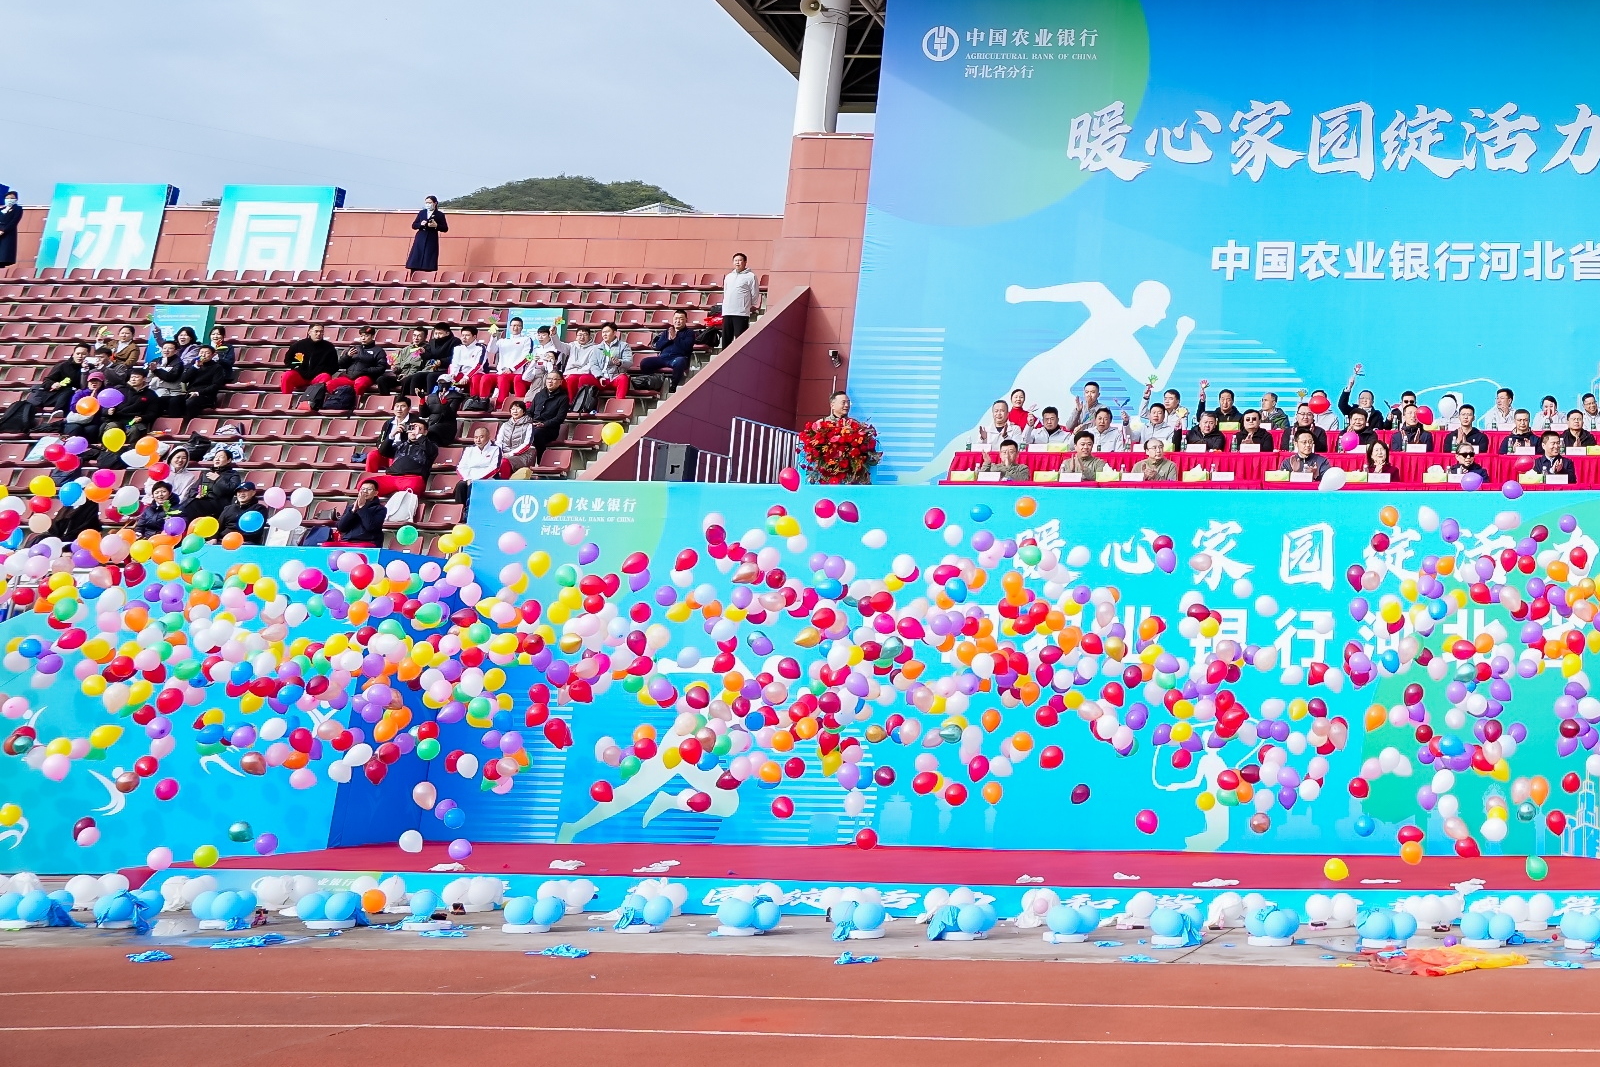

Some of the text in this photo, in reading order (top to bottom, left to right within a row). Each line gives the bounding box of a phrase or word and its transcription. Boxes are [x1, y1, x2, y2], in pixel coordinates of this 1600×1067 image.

[966, 27, 1099, 47] 中国农业银行
[965, 52, 1028, 60] AGRICULTURAL
[1031, 52, 1054, 60] BANK
[964, 64, 1035, 79] 河北省分行
[57, 196, 319, 279] 协 同
[544, 497, 637, 513] 农业银行
[541, 525, 590, 536] 河北行
